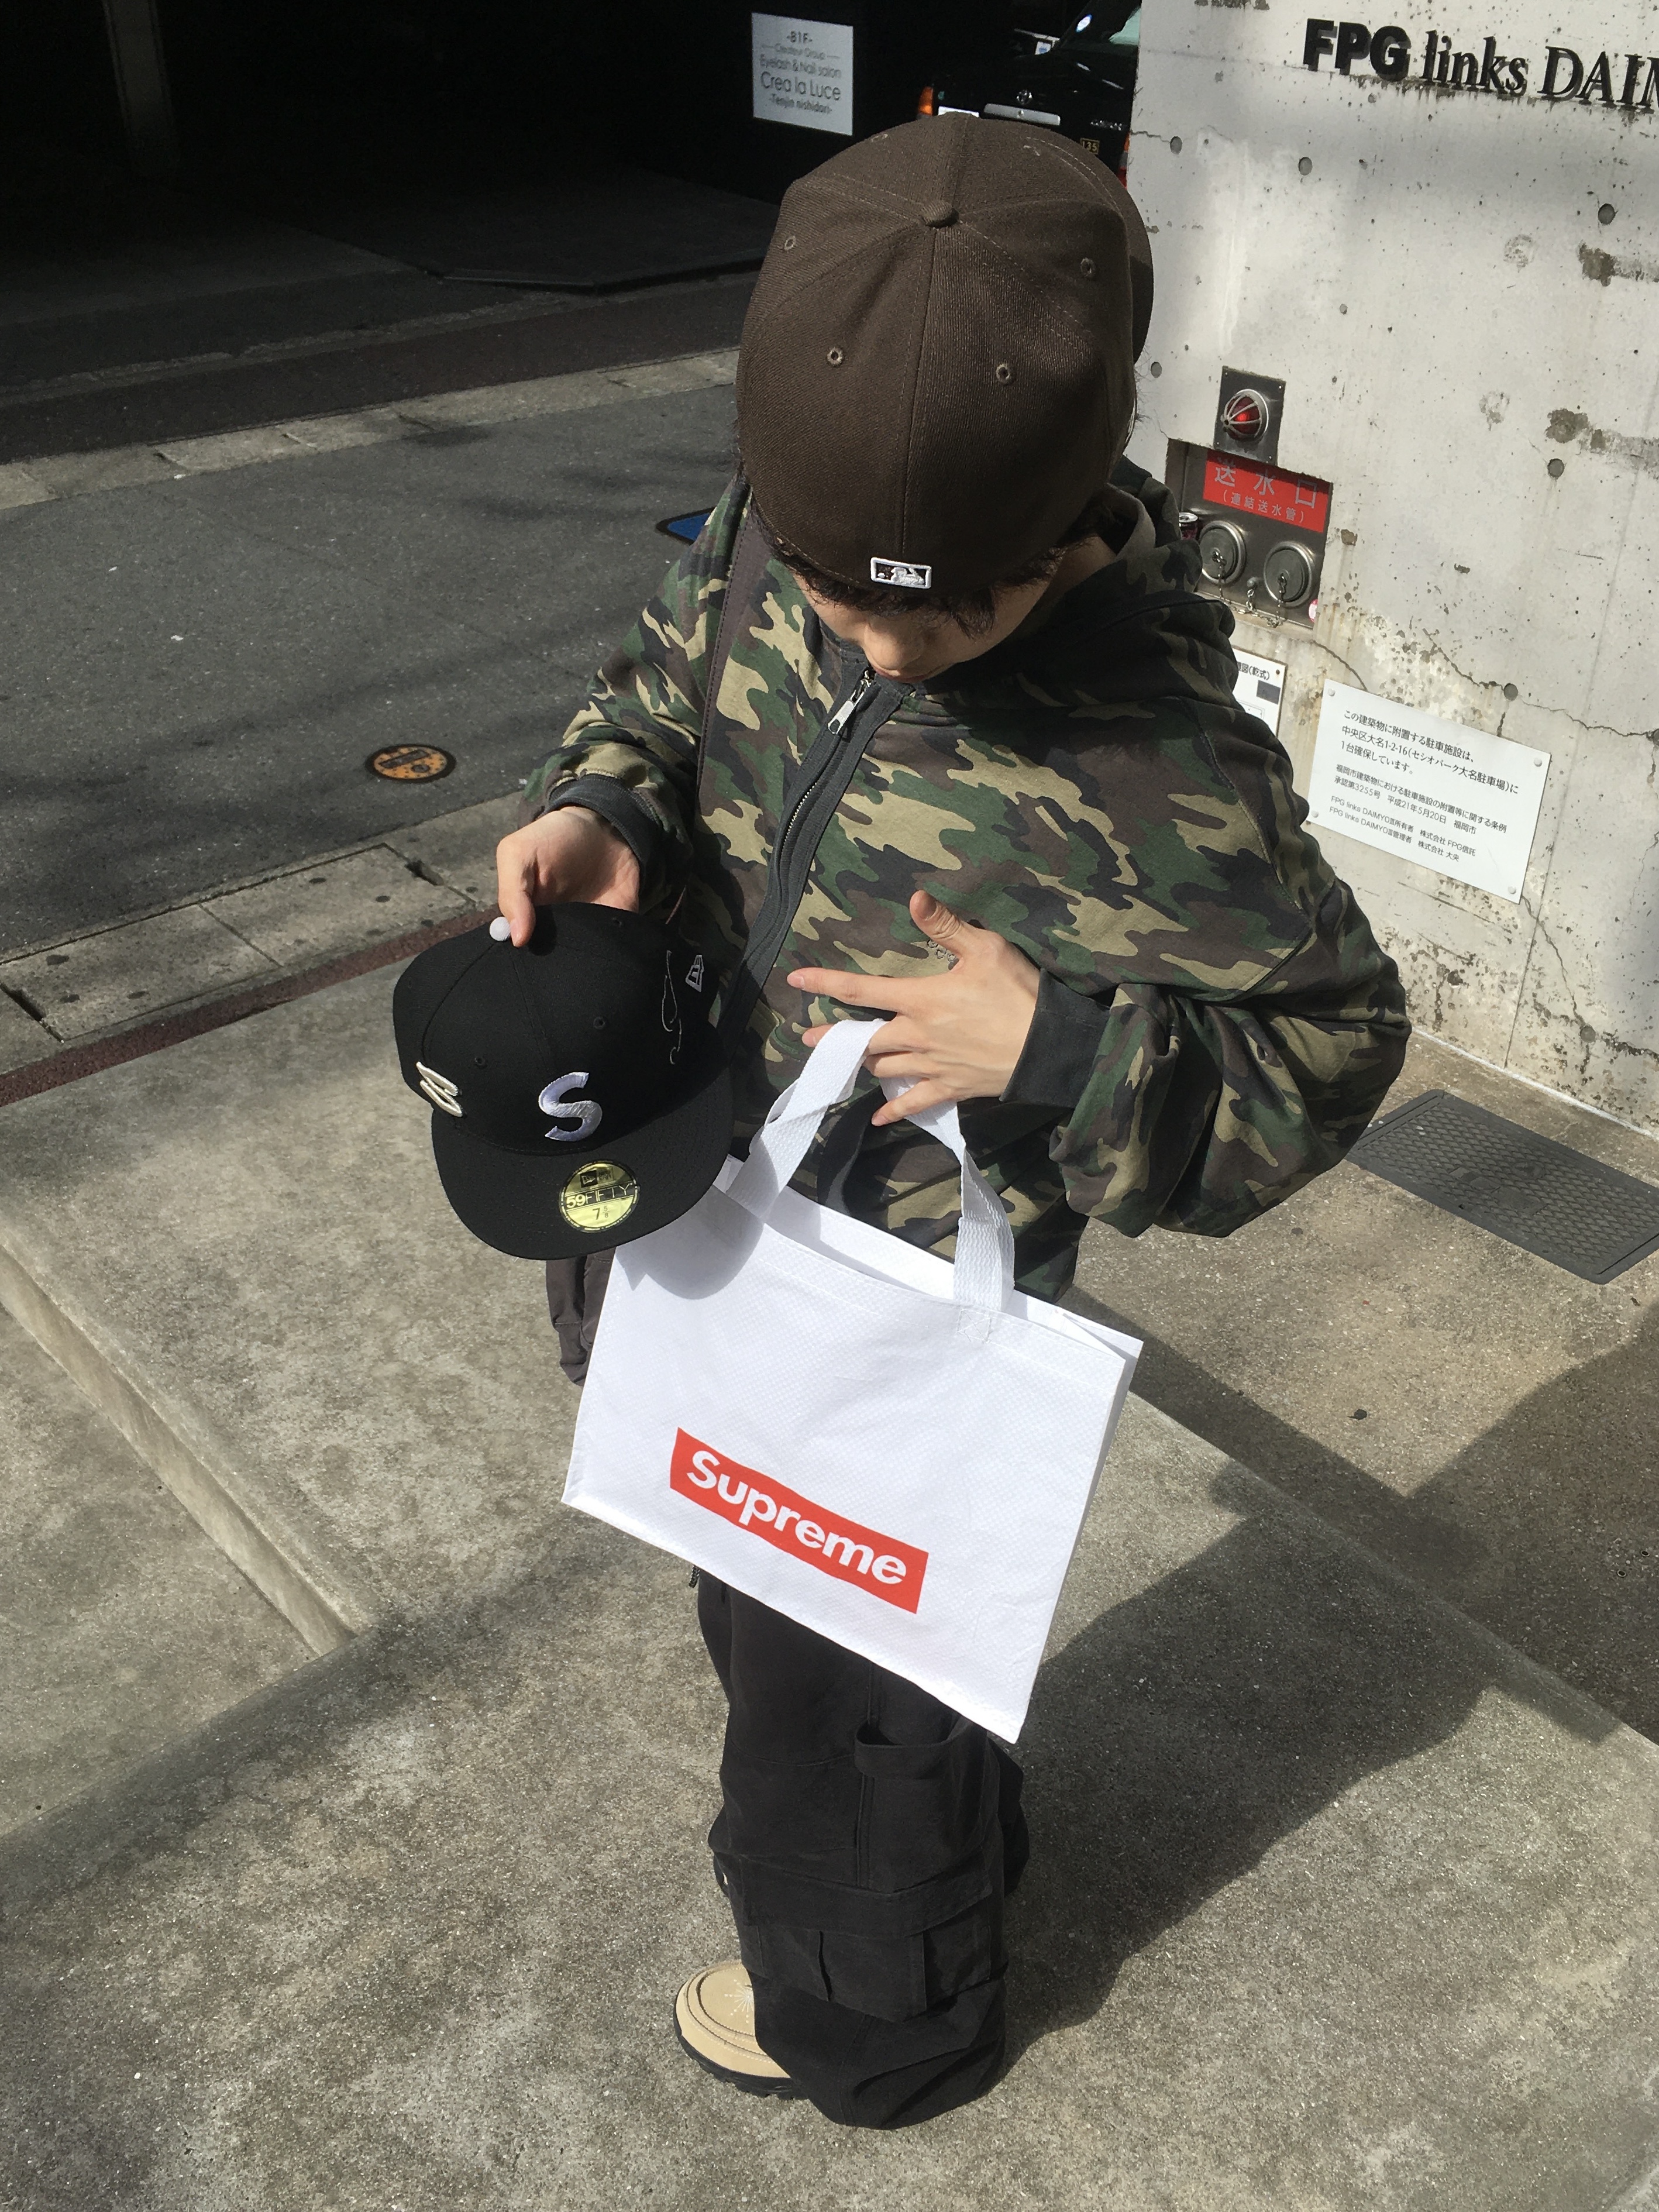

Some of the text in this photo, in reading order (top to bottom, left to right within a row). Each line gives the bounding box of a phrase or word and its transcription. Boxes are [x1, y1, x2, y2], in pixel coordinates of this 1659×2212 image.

[1303, 18, 1410, 80] FPG
[1419, 29, 1527, 92] links
[760, 71, 841, 101] Crea la Luce
[1214, 456, 1317, 509] 送水口
[1341, 740, 1413, 775] 1台確保しています。
[1344, 710, 1474, 762] この建築物に附置する駐車施設は、
[1329, 806, 1344, 817] FPG
[1344, 812, 1359, 823] links
[1417, 840, 1444, 856] 株式会社
[1331, 795, 1345, 806] FPG
[1346, 801, 1361, 813] links
[1419, 829, 1446, 845] 株式会社
[1387, 794, 1447, 824] 平成21年5月20日
[1453, 819, 1476, 835] 福岡市
[538, 1071, 603, 1142] S
[566, 1183, 631, 1209] 59FIFTY
[687, 1450, 907, 1585] Supreme
